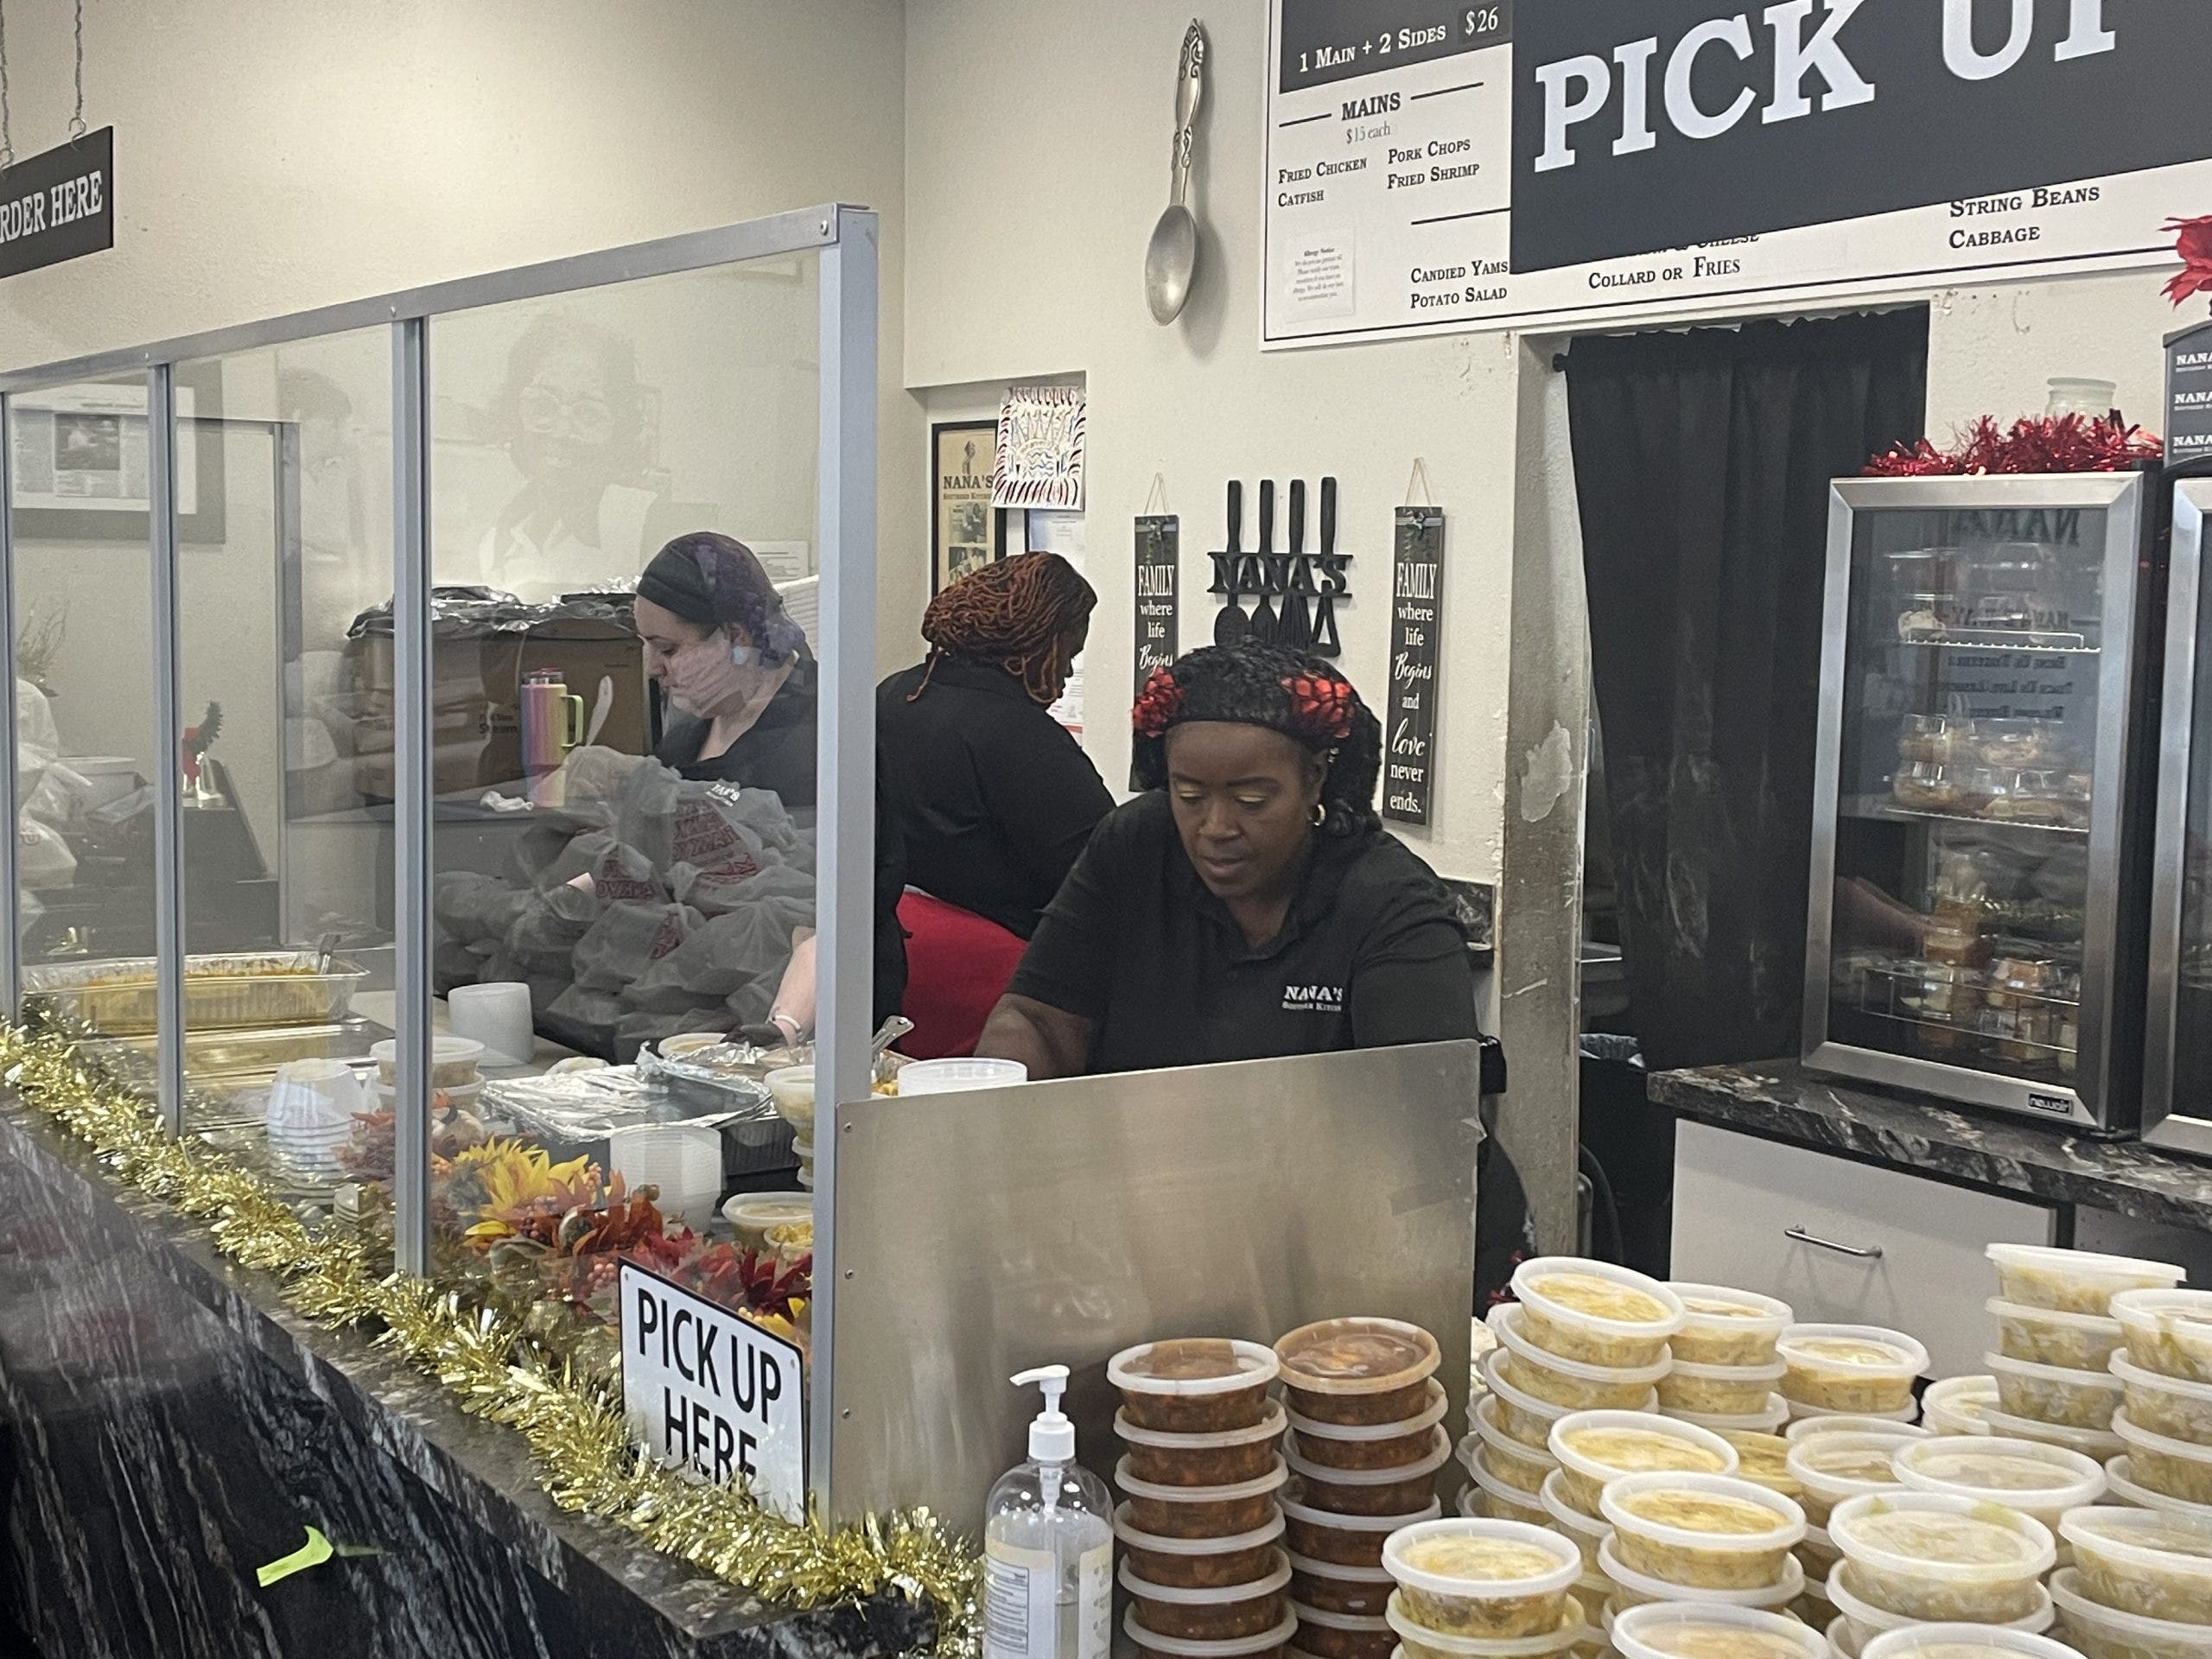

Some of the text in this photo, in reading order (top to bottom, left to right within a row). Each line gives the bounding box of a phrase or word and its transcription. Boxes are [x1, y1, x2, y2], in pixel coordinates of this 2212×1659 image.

[1300, 53, 1308, 73] 1
[1315, 46, 1356, 68] MAIN
[1379, 34, 1391, 54] 2
[1398, 26, 1446, 49] SIDES
[1465, 6, 1498, 35] $26
[1534, 0, 1874, 172] PICK
[1342, 92, 1401, 121] MAINS
[1368, 124, 1390, 139] each
[1389, 139, 1471, 164] PORK CHOPS
[1279, 157, 1367, 184] FRIED CHICKEN
[1388, 164, 1479, 189] FRIED SHRIMP
[50, 170, 103, 227] HERE
[1278, 190, 1324, 207] CATFISH
[1950, 187, 2100, 217] STRING BEANS
[1949, 226, 2040, 249] CABBAGE
[1411, 260, 1508, 283] CANDIED YAMS
[1589, 269, 1656, 289] COLLARD
[1693, 256, 1740, 277] FRIES
[1410, 287, 1507, 308] POTATO SALAD
[944, 475, 993, 490] NANA'S
[1138, 565, 1174, 596] FAMILY
[1396, 563, 1437, 599] FAMILY
[1140, 600, 1173, 615] where
[1397, 601, 1433, 621] where
[1147, 622, 1165, 638] life
[1405, 627, 1424, 646] life
[1140, 644, 1173, 677] Begins
[1395, 652, 1433, 690] Begins
[1402, 693, 1420, 709] and
[1392, 718, 1426, 756] love
[1390, 764, 1424, 783] never
[1389, 791, 1421, 813] ends.
[638, 1287, 782, 1425] PICK UP
[664, 1386, 757, 1485] HERE
